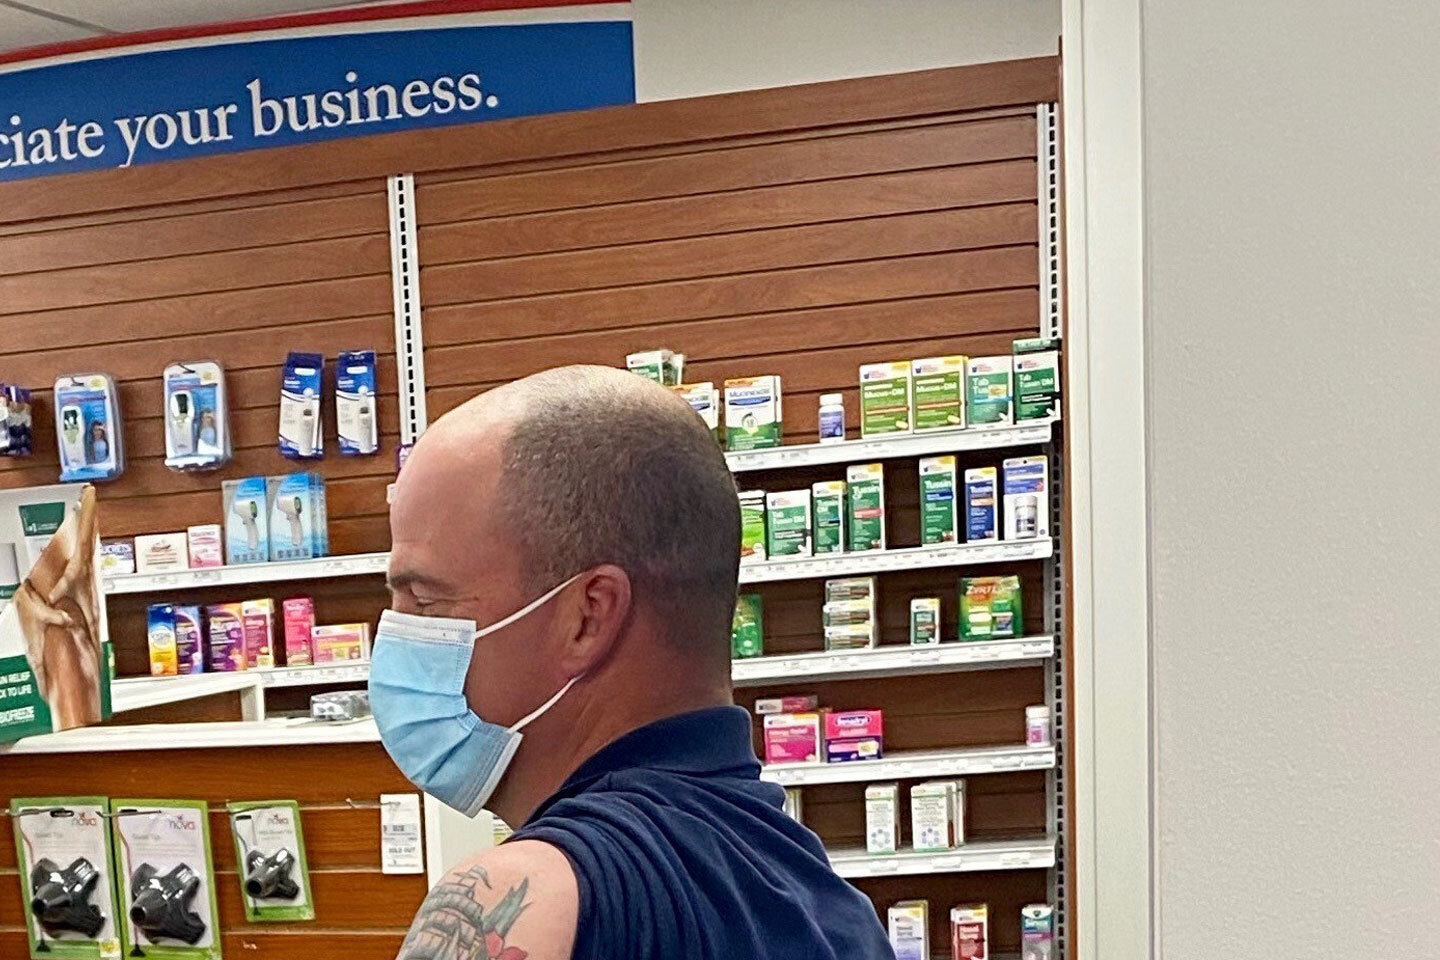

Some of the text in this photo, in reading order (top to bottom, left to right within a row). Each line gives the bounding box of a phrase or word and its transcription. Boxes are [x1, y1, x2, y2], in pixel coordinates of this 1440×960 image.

[114, 101, 238, 168] your
[246, 70, 500, 138] business.
[8, 671, 31, 683] RELIEF
